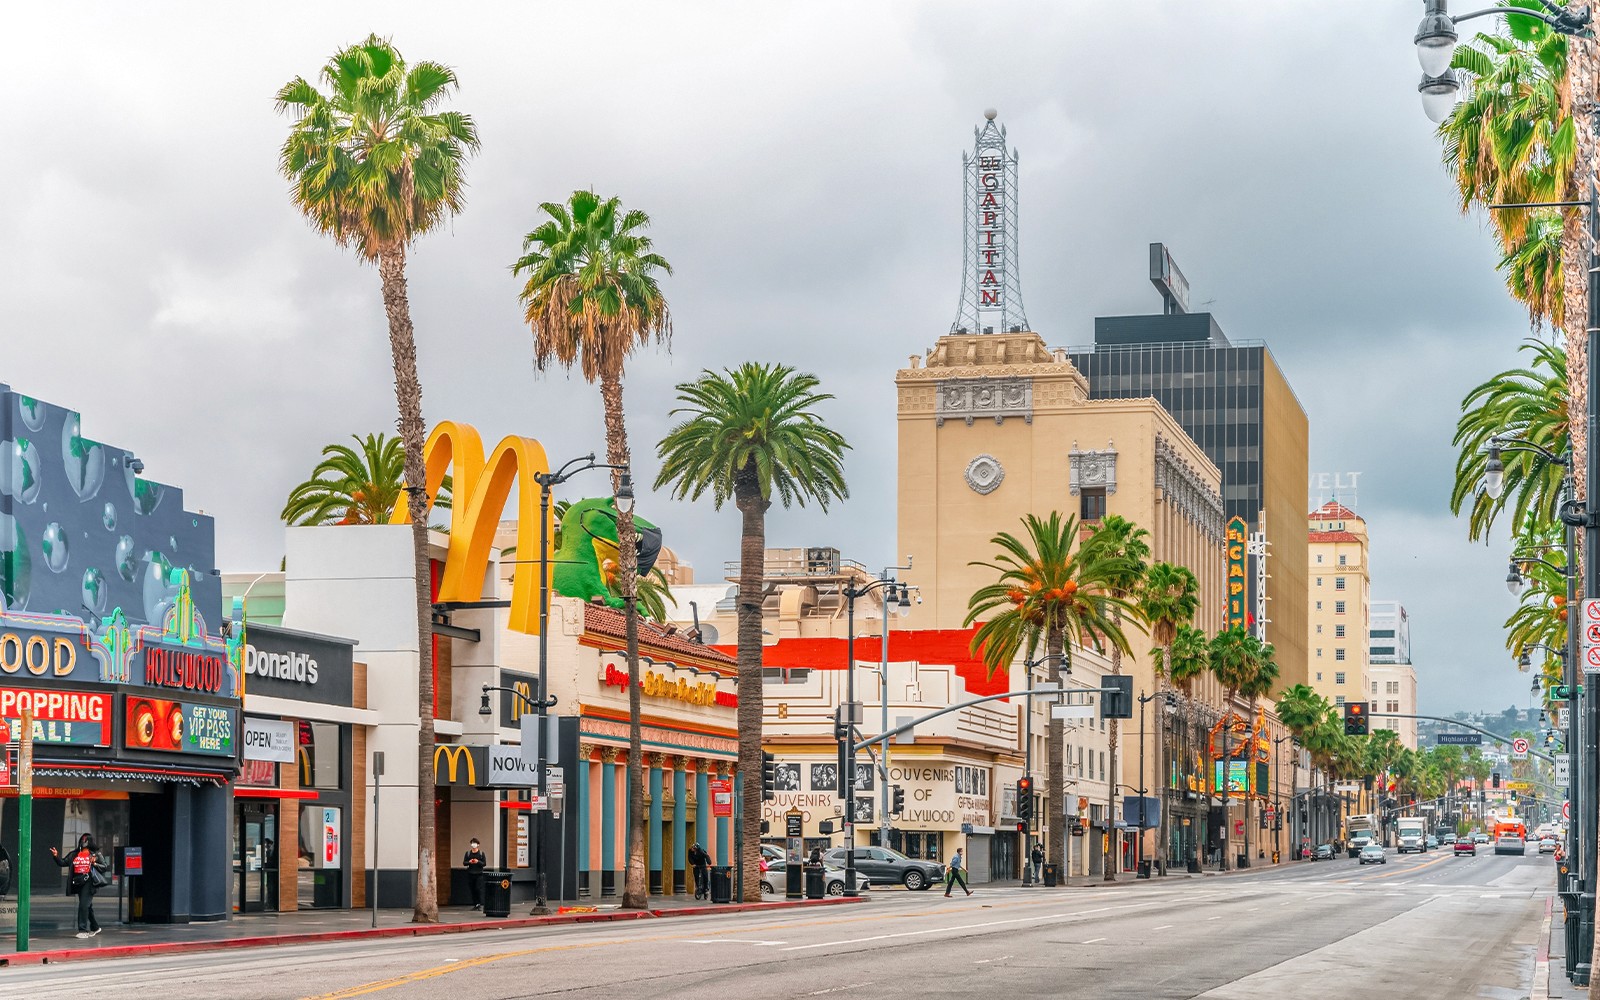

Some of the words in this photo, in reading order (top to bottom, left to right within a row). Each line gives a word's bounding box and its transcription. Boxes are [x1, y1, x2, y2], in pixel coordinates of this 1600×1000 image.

[981, 173, 999, 305] CAPITAN
[1228, 529, 1244, 544] EL
[146, 646, 222, 693] HOLLYWOOD
[245, 643, 319, 684] Donald's
[1, 690, 103, 721] POPPING
[193, 706, 206, 718] GET
[208, 708, 228, 721] YOUR
[12, 719, 71, 742] EAL!
[189, 717, 205, 736] VIP
[206, 719, 231, 739] PASS
[200, 736, 221, 750] HERE
[245, 730, 271, 748] OPEN
[1441, 735, 1467, 743] Highland
[493, 757, 525, 771] NOW
[890, 767, 954, 782] OUVENIRS
[914, 788, 932, 801] OF
[764, 807, 811, 823] PHO
